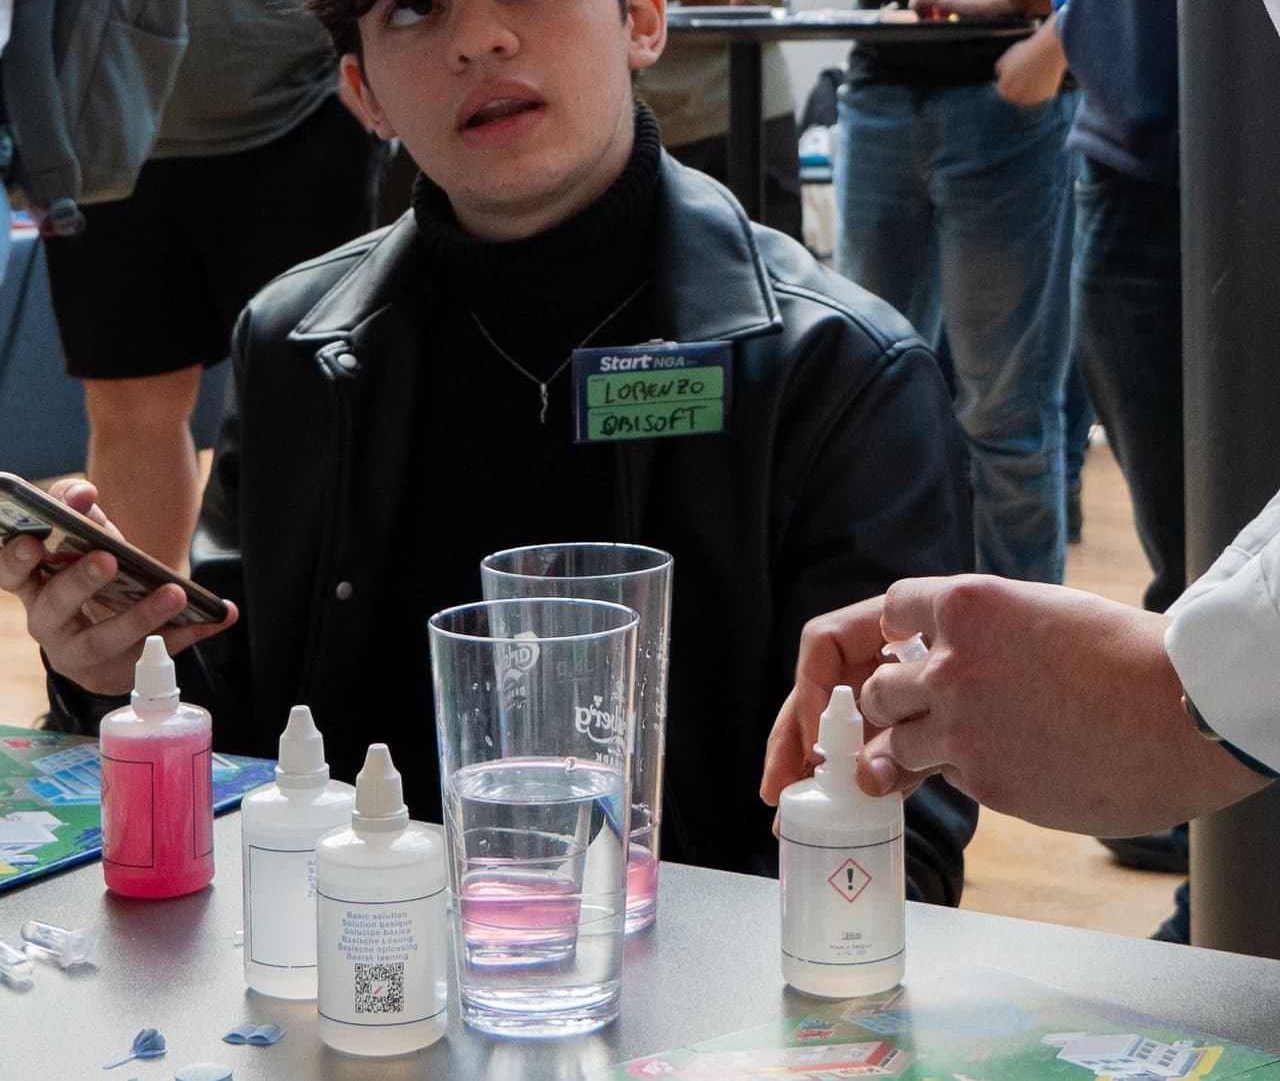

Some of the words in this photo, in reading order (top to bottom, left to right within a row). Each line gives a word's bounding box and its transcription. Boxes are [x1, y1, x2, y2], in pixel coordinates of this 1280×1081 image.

[599, 354, 653, 372] Start
[653, 356, 685, 368] NGA
[604, 378, 705, 405] LORENZO
[372, 911, 408, 919] solution
[342, 918, 377, 928] Solution
